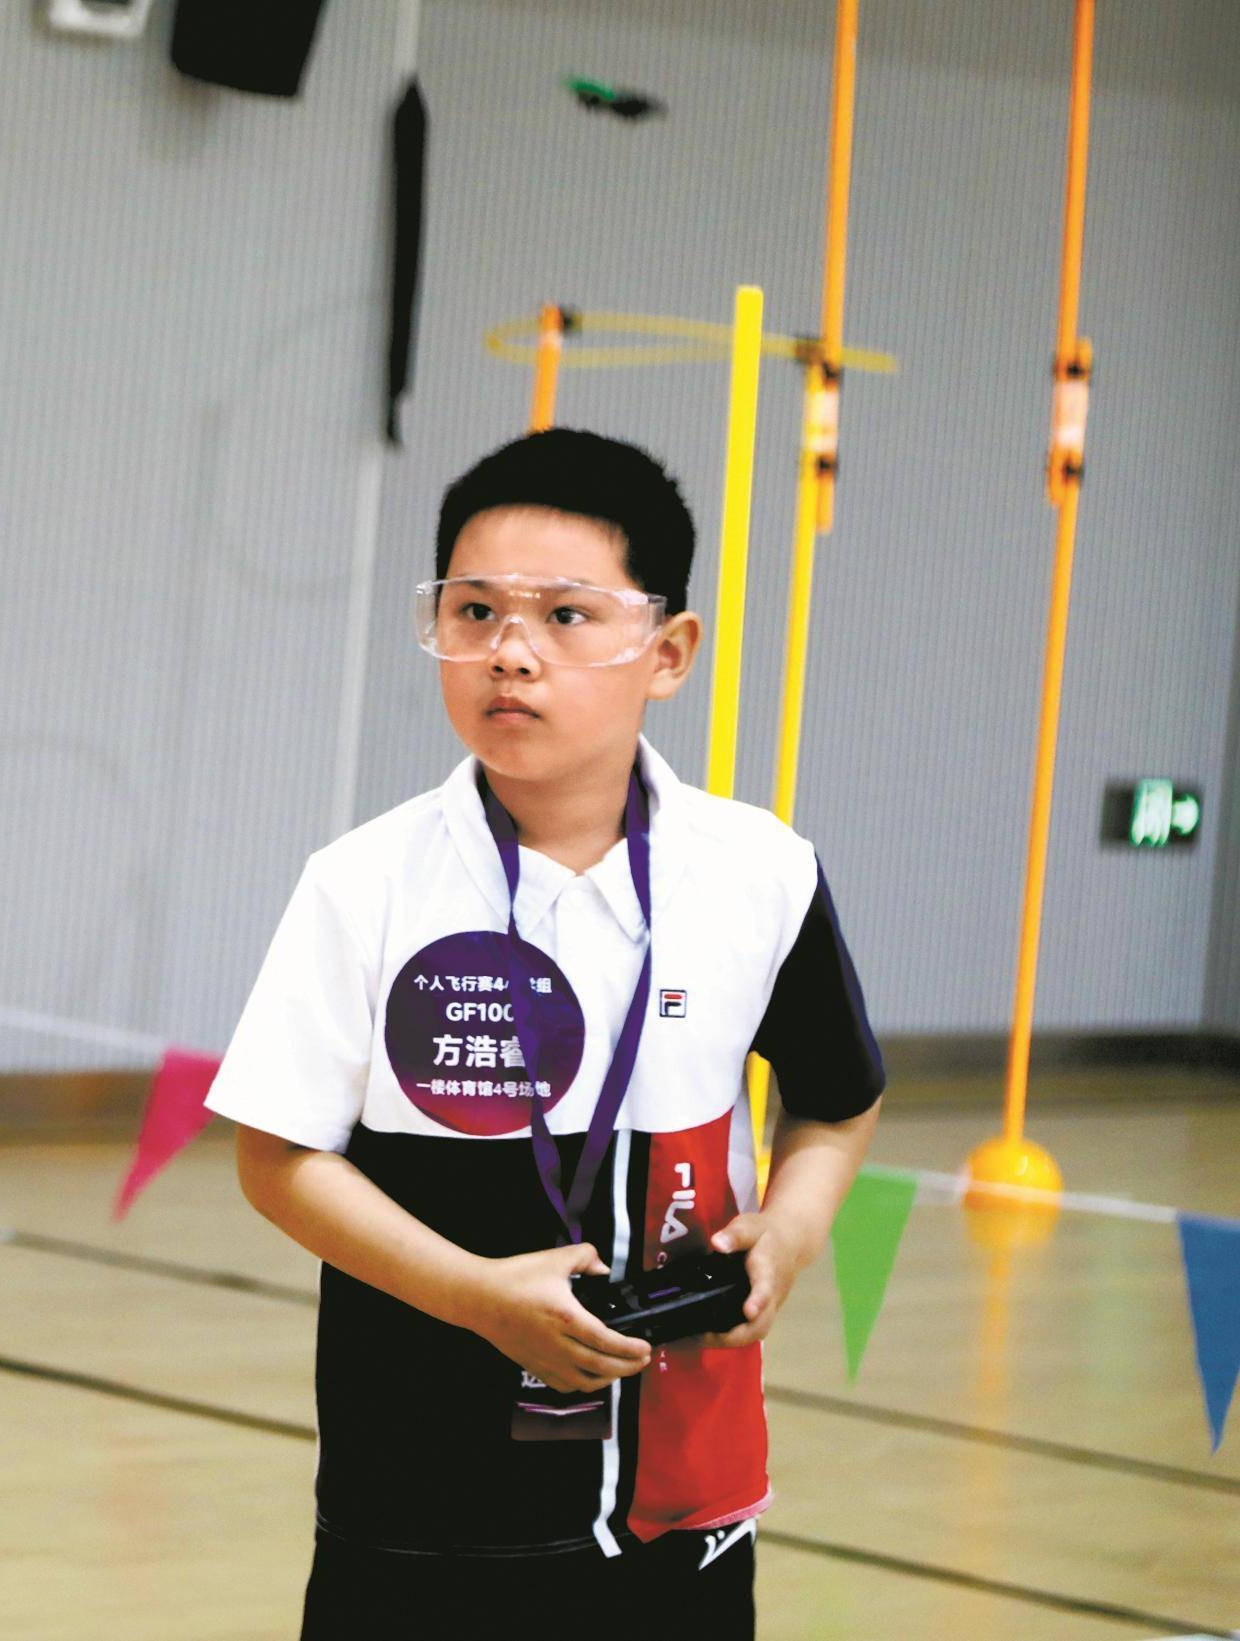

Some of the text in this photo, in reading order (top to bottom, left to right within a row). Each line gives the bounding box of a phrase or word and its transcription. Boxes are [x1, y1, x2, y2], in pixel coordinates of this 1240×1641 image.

[413, 974, 553, 994] 个人飞行赛4组
[660, 1162, 696, 1244] FILA
